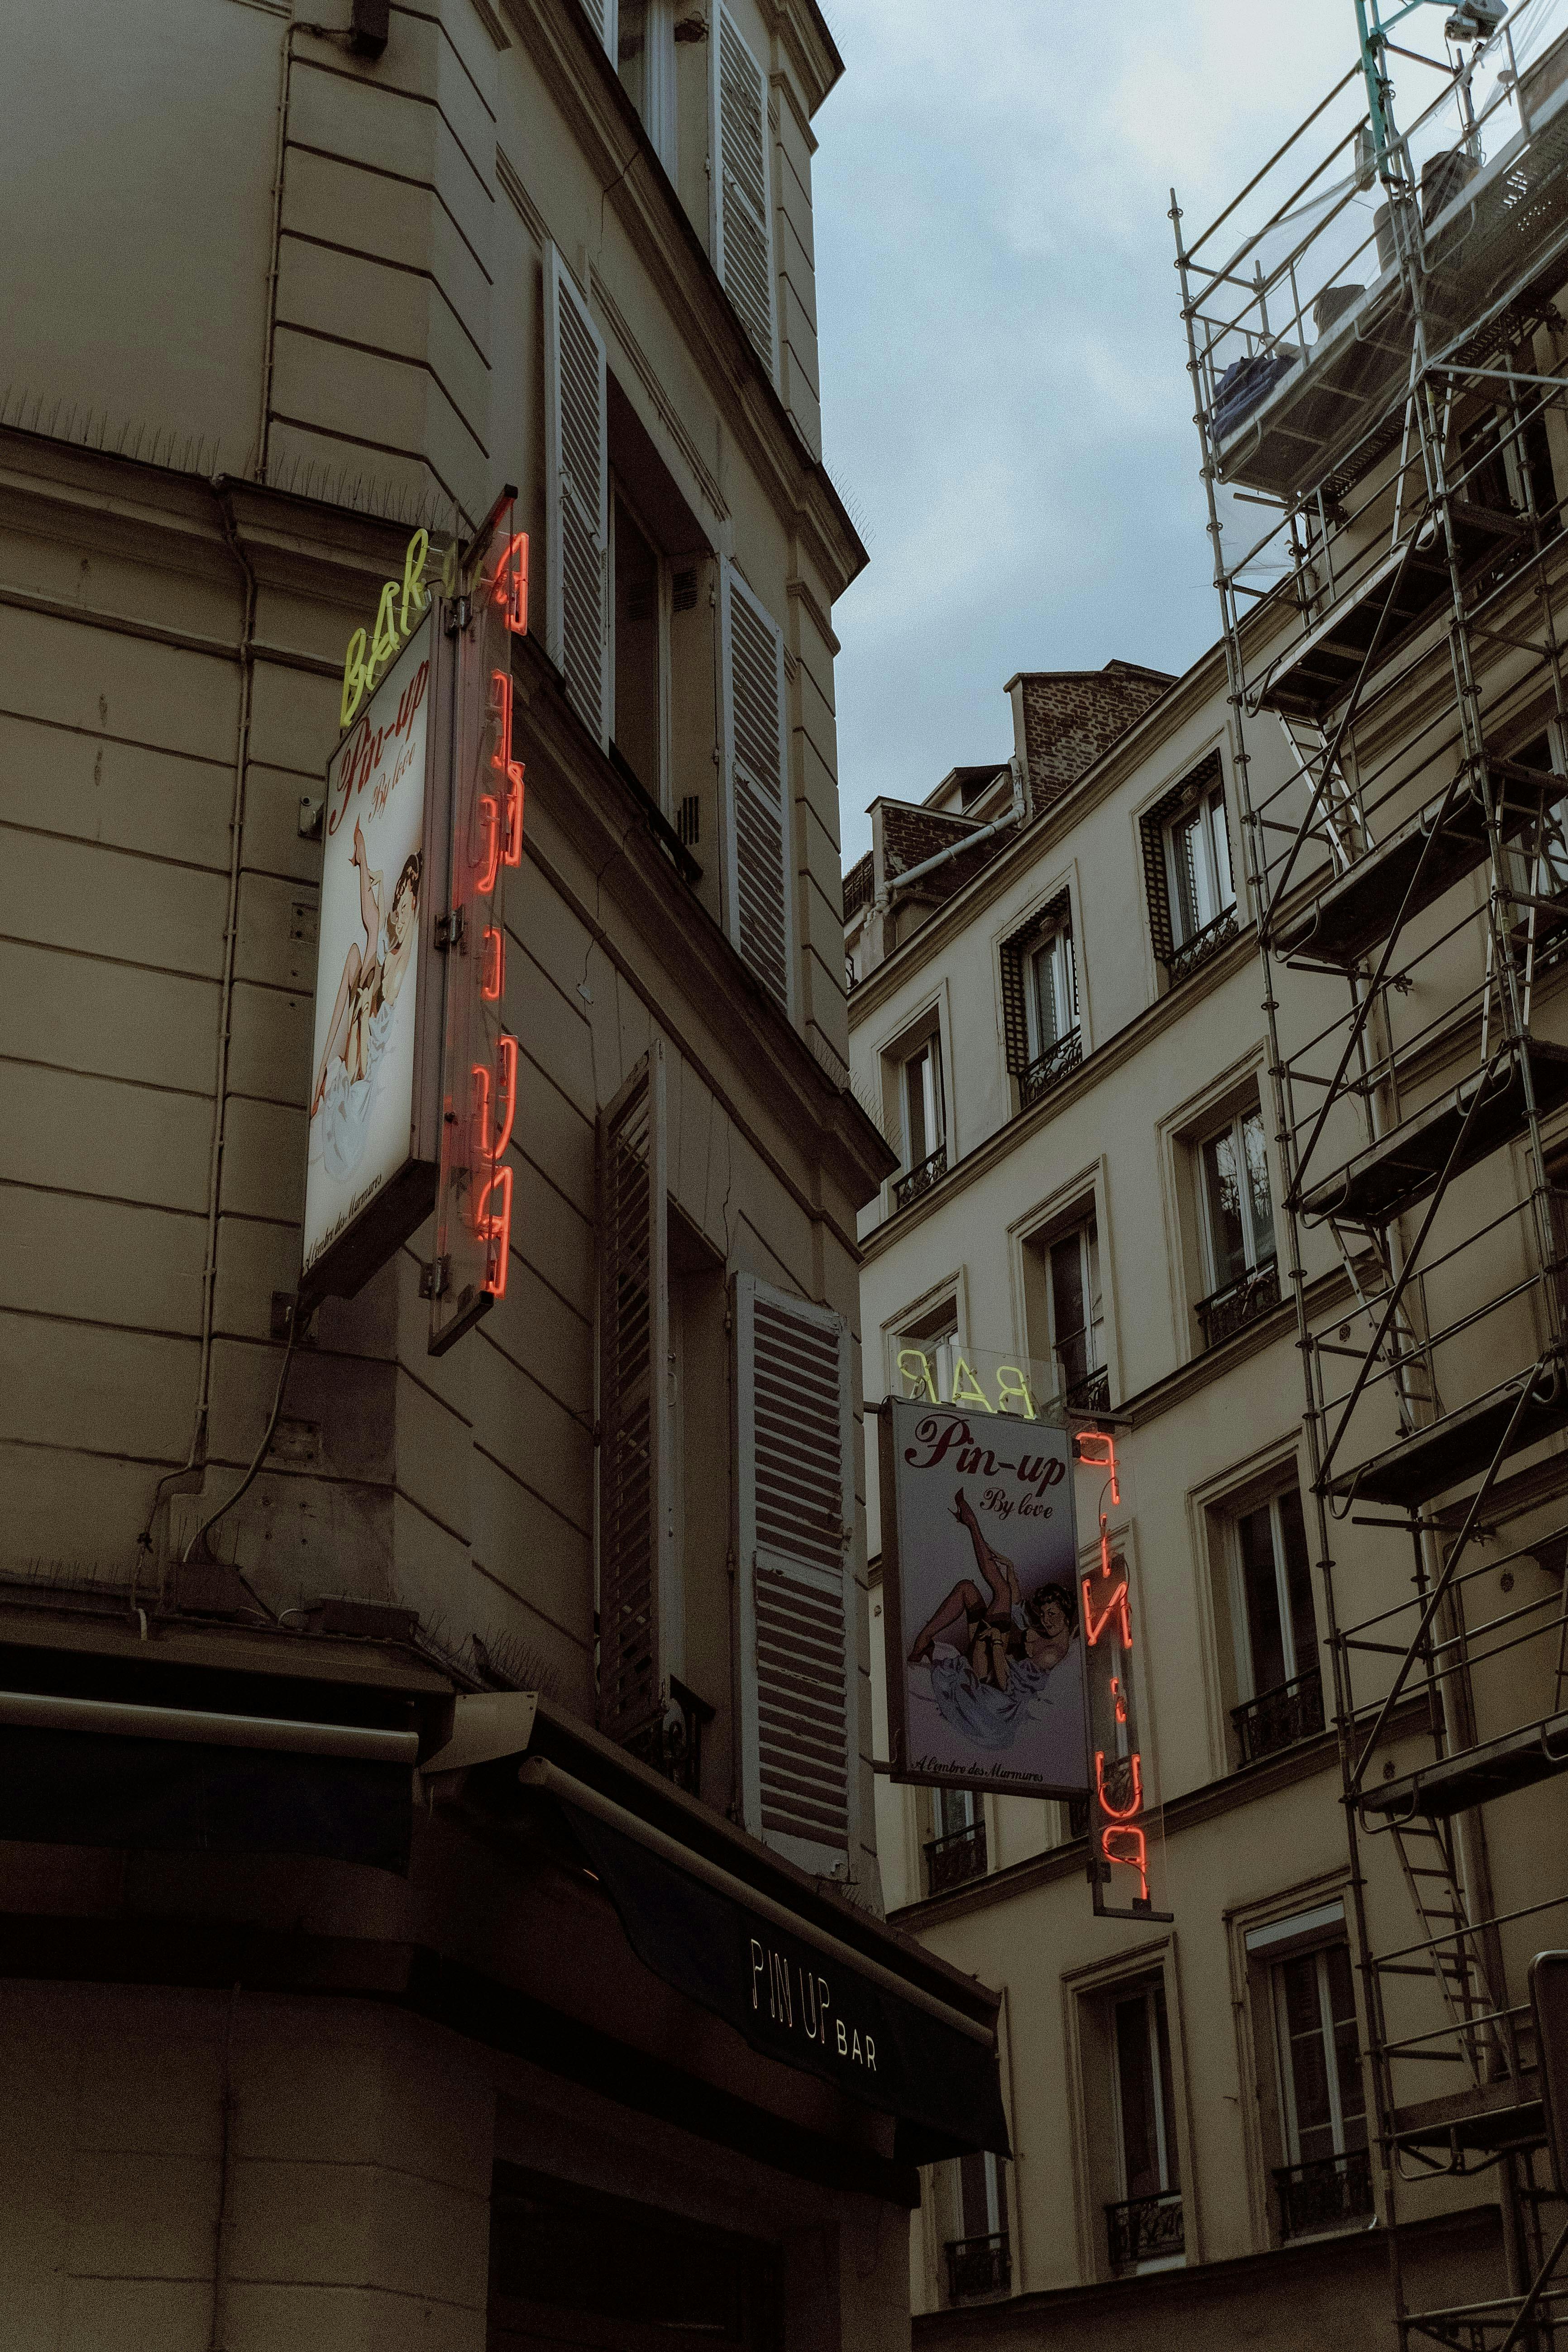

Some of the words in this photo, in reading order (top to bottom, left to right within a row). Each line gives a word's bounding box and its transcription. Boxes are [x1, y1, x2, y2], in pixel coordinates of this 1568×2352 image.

[340, 528, 430, 727] BAR
[329, 660, 429, 836] Pin-up
[368, 771, 391, 823] By
[392, 742, 416, 789] love
[905, 1414, 1066, 1497] Pin-up
[980, 1487, 1015, 1521] By
[1018, 1493, 1053, 1519] love
[968, 1762, 985, 1775] des
[751, 1938, 793, 2027] PIN
[799, 1967, 830, 2045] UP
[836, 2019, 877, 2071] BAR
